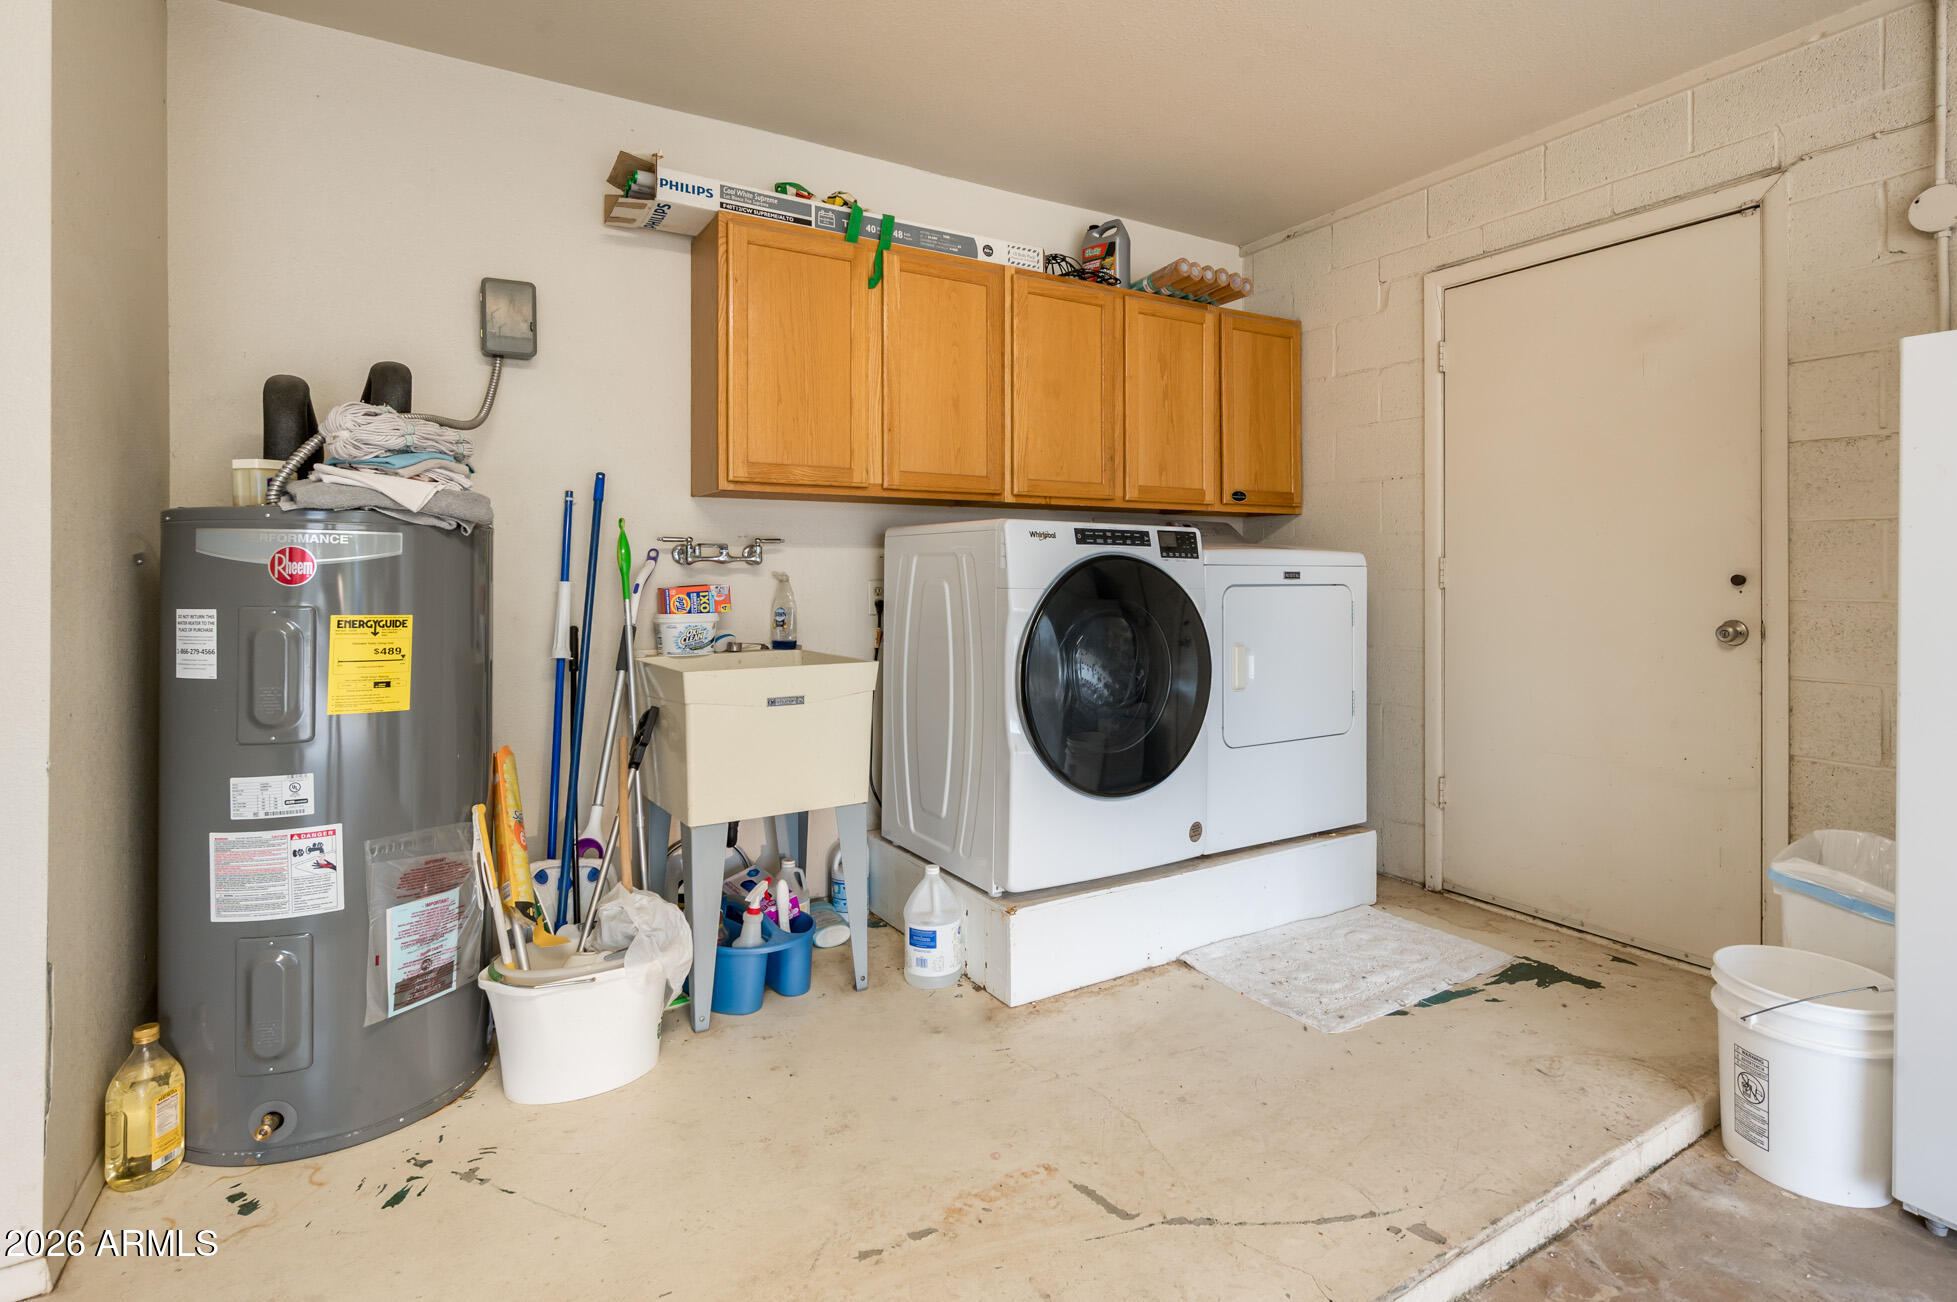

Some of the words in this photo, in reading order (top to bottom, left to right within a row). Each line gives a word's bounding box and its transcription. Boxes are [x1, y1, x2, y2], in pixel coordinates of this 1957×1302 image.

[659, 177, 714, 199] PHILIPS
[723, 186, 736, 195] Cool
[736, 189, 754, 198] White
[754, 193, 778, 204] Supreme
[643, 203, 672, 230] PHILIPS
[865, 224, 876, 233] 40
[1028, 530, 1056, 541] Whirlpool
[274, 547, 313, 580] Rheem
[675, 596, 689, 612] Tide
[700, 592, 710, 613] OXI
[336, 619, 409, 630] ENERGYGUIDE
[373, 647, 402, 656] $489
[300, 830, 335, 840] DANGER
